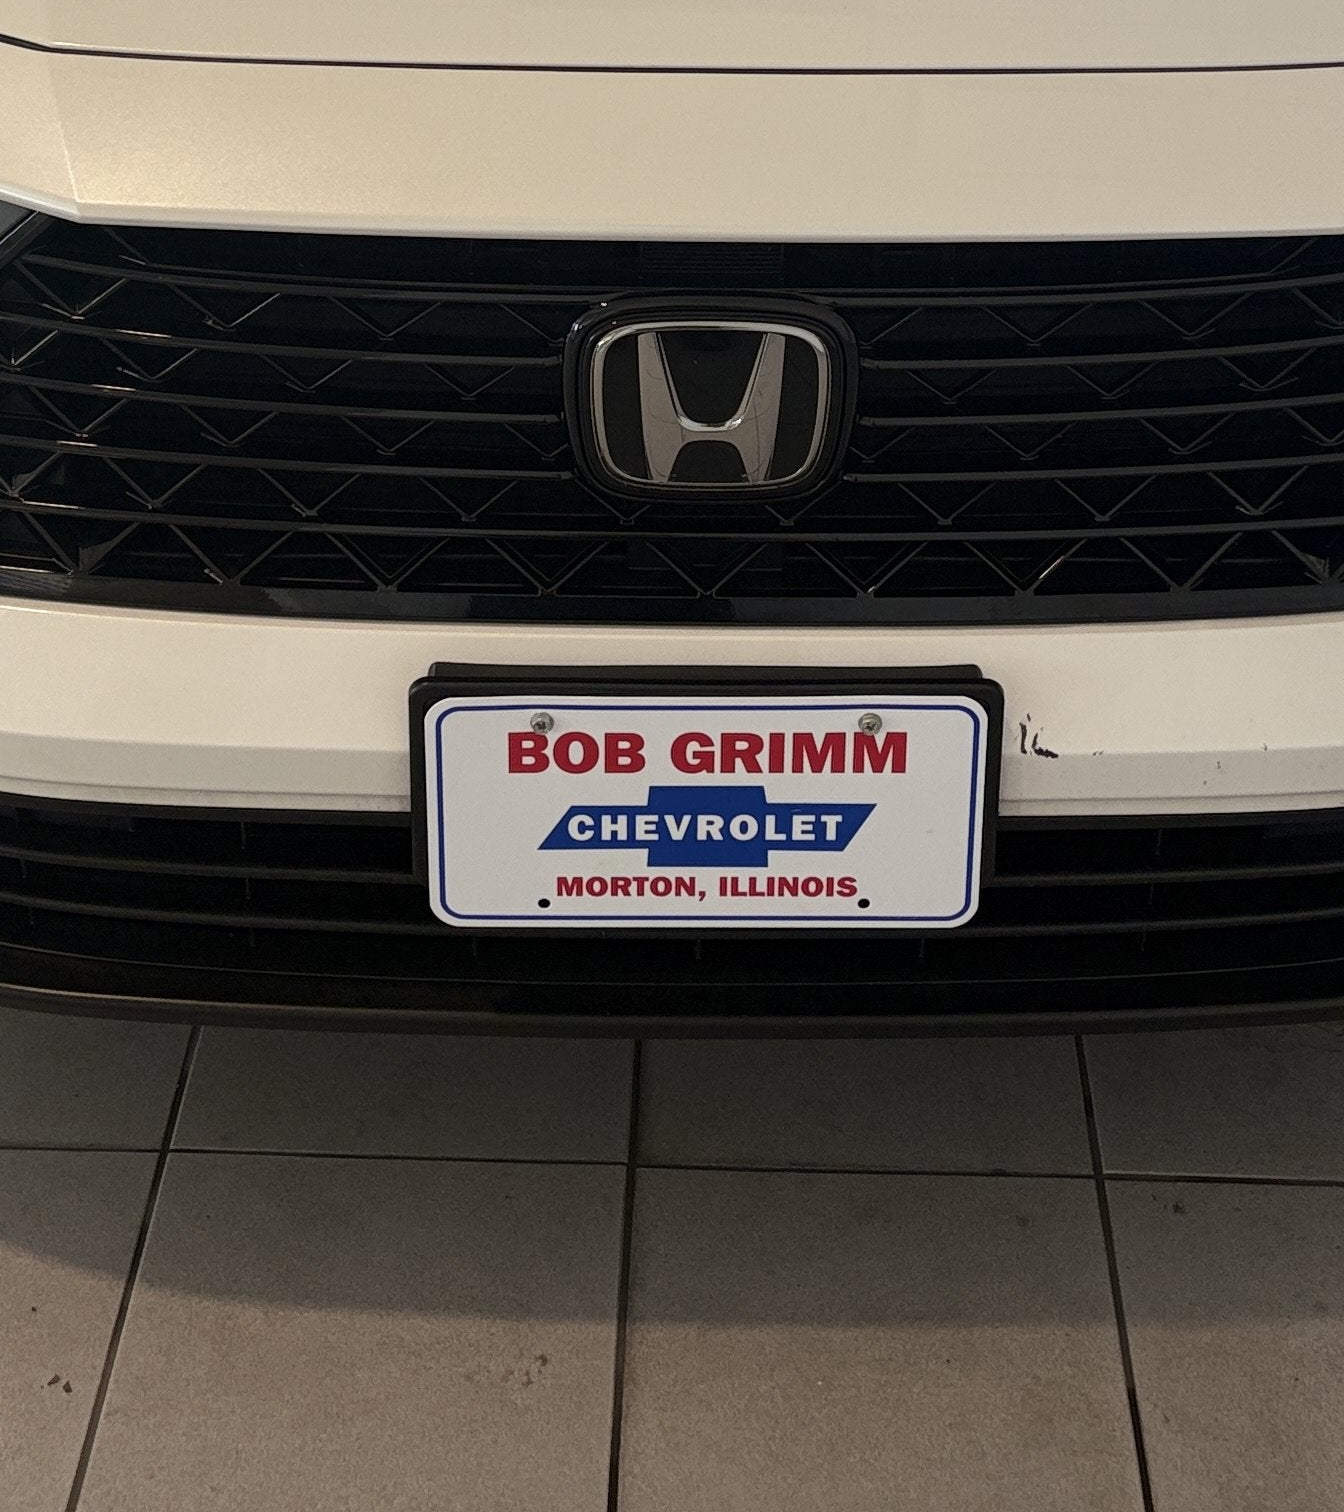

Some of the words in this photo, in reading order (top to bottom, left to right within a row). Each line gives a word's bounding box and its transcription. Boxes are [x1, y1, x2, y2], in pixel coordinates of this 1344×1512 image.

[507, 731, 646, 774] BOB
[670, 731, 908, 774] GRIMM
[567, 814, 844, 841] CHEVROLET
[555, 876, 707, 900] MORTON,
[718, 875, 859, 898] ILLINOIS
